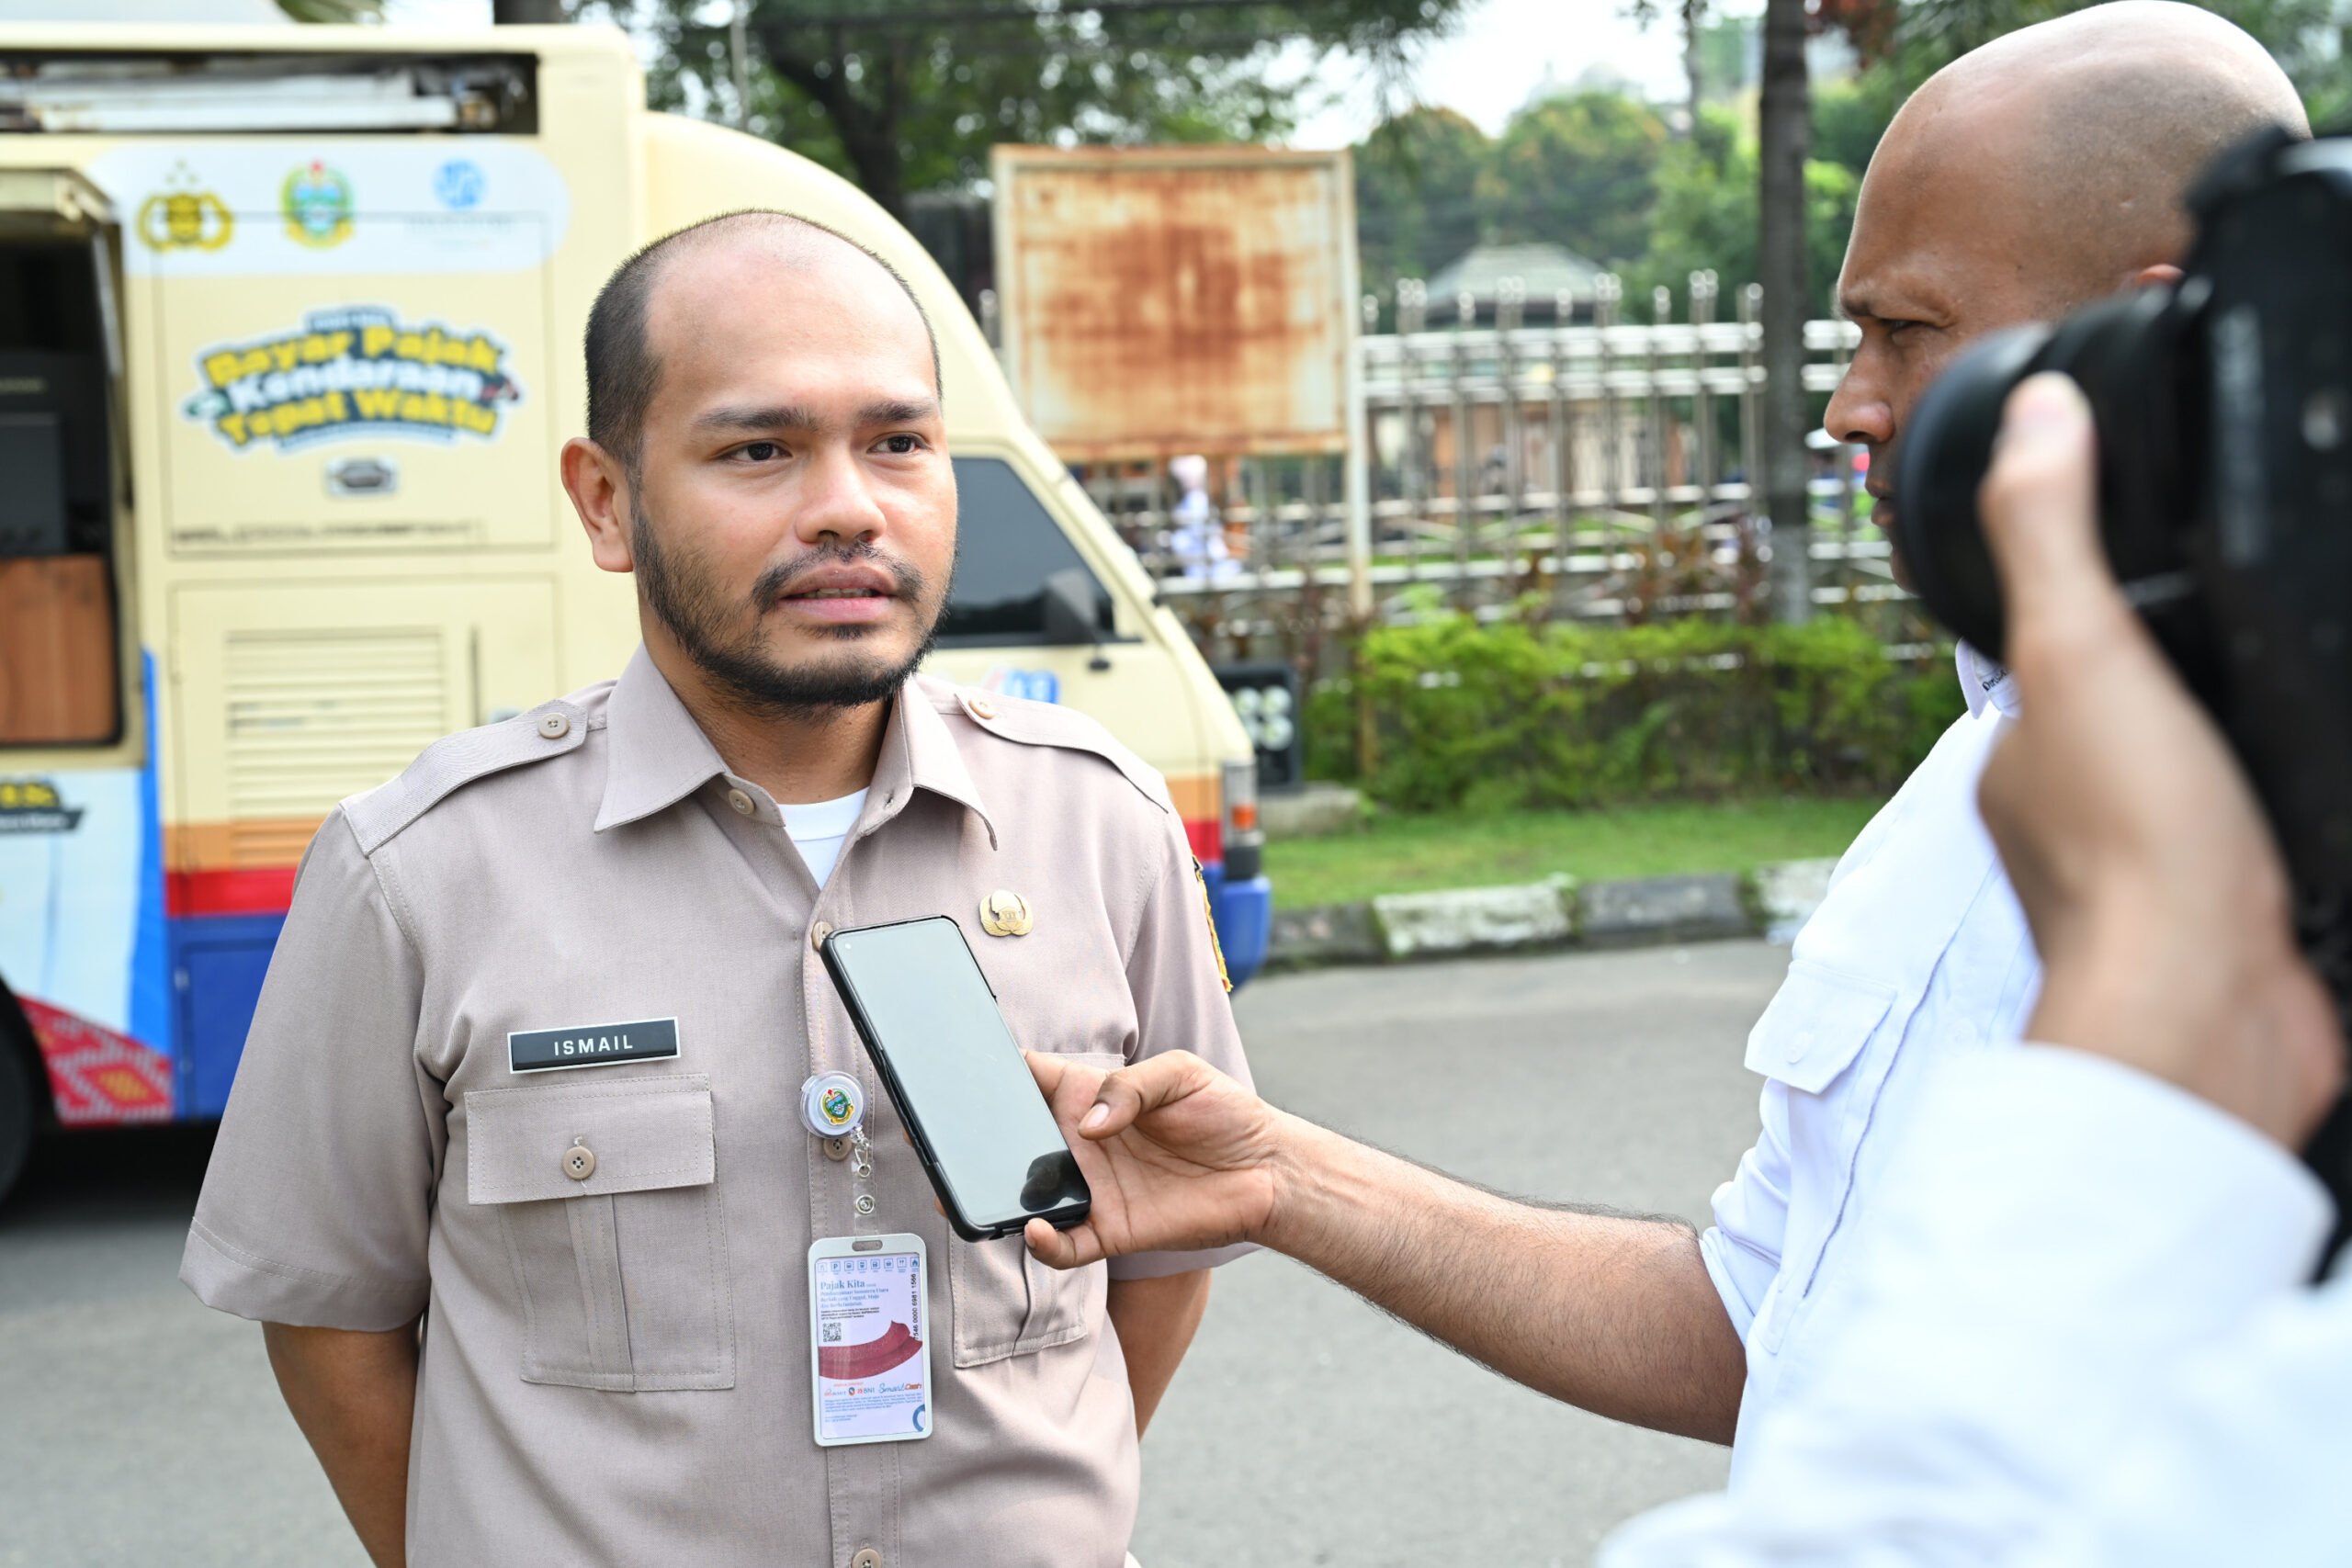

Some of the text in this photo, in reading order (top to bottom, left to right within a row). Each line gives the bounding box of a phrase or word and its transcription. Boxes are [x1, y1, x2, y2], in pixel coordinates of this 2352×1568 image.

[203, 326, 501, 388] Bayar Pajak
[228, 356, 484, 412] Kendaraan
[218, 388, 497, 446] Tepat Waktu
[554, 1034, 633, 1056] ISMAIL
[820, 1280, 865, 1291] Pajak Kita
